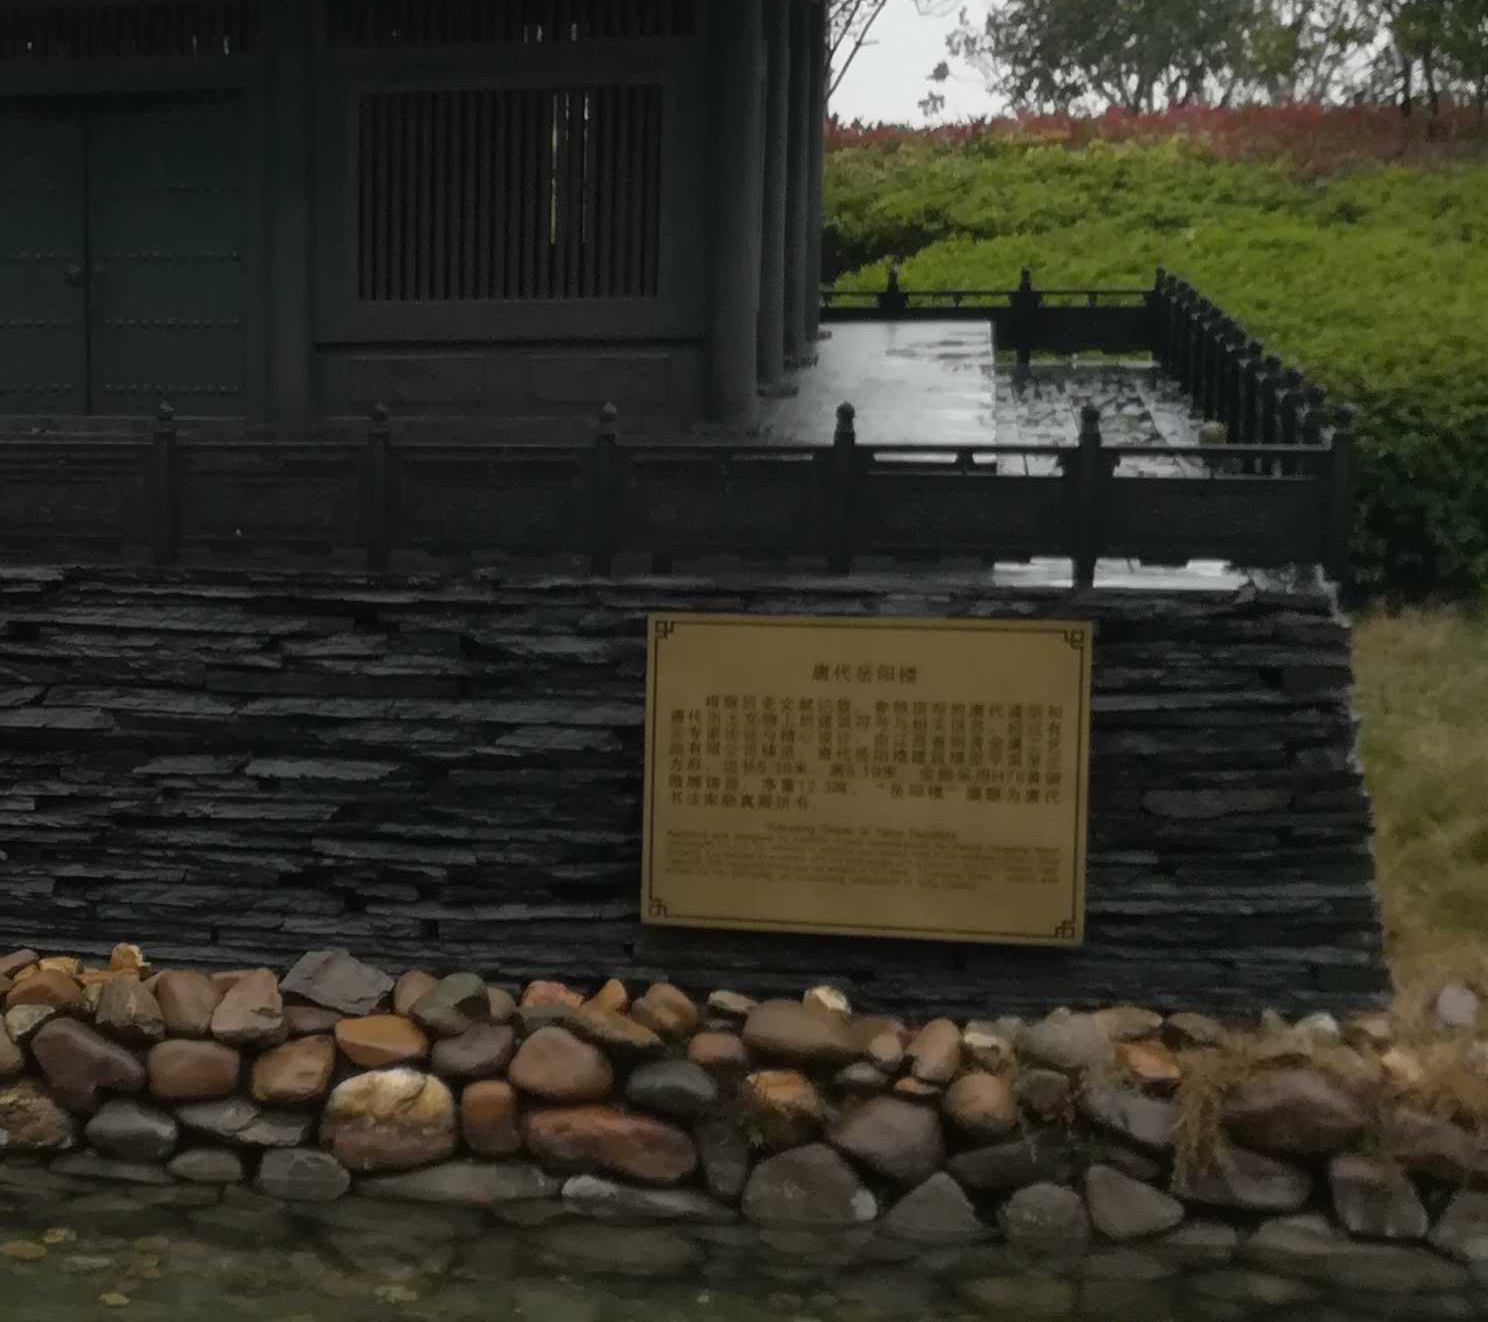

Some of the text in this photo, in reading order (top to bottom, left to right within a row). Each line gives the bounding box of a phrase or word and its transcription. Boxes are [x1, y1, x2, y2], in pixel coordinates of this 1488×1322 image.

[811, 661, 918, 685] 唐代岳阳楼
